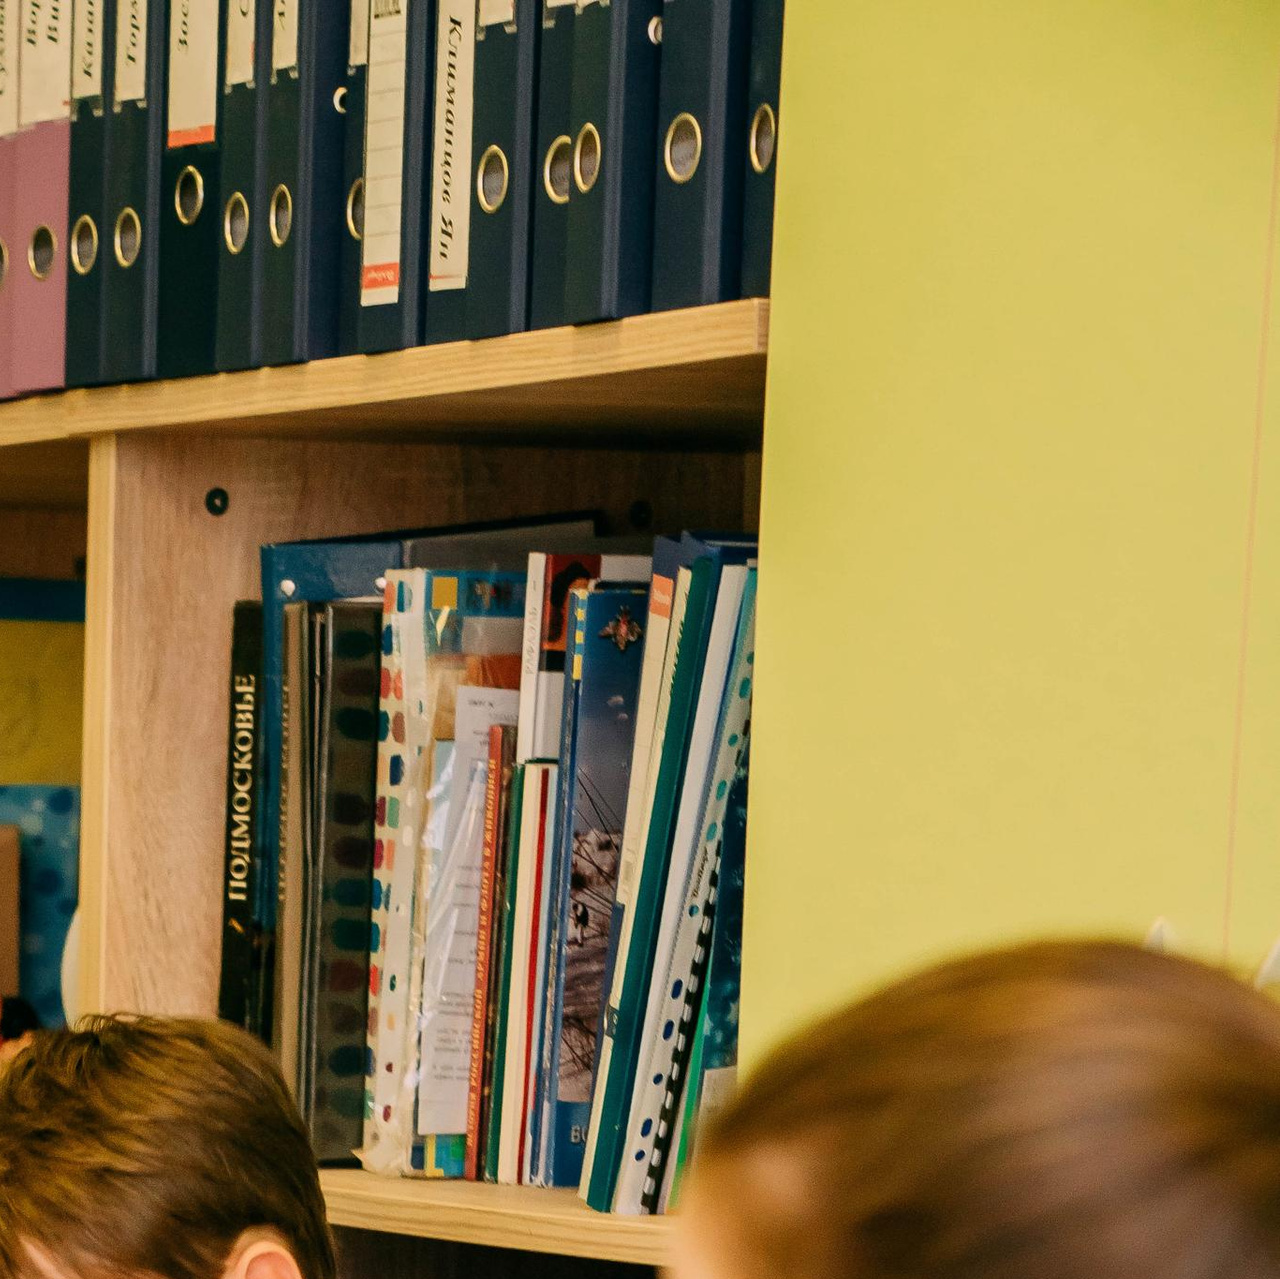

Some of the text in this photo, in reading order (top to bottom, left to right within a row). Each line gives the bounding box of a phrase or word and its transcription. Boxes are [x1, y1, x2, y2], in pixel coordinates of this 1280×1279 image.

[439, 15, 463, 260] Климанцов Ян
[228, 674, 256, 900] ПОДМОСКОВЬЕ
